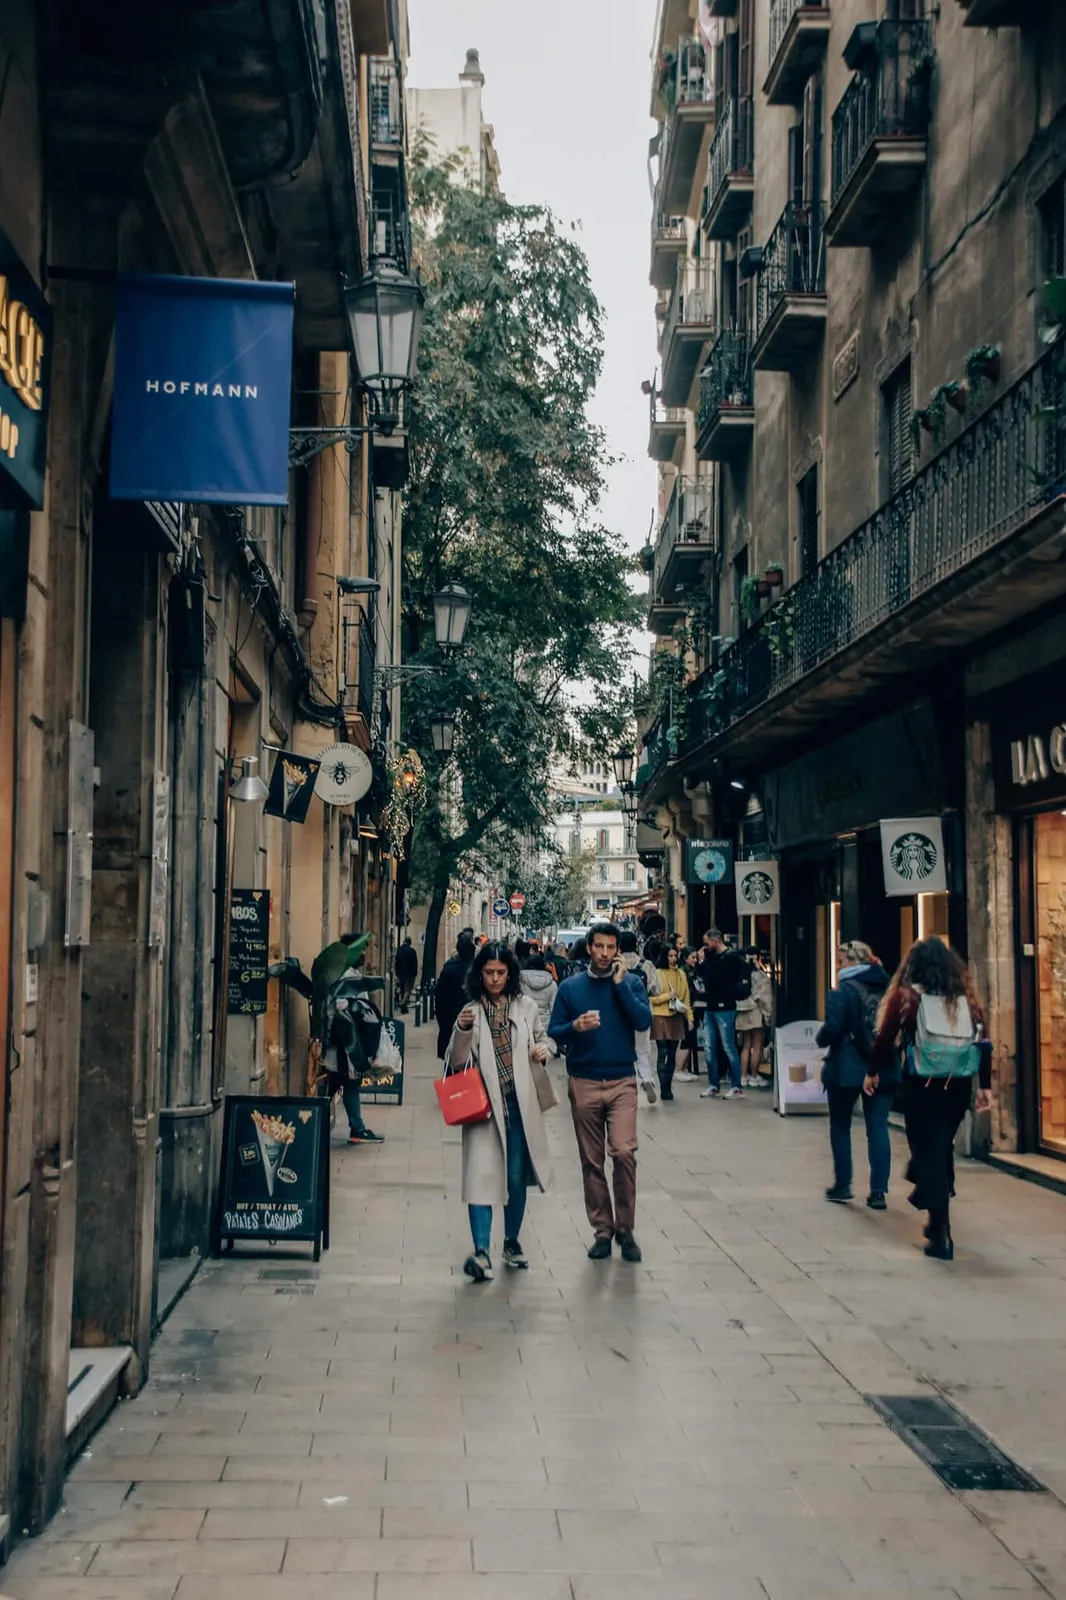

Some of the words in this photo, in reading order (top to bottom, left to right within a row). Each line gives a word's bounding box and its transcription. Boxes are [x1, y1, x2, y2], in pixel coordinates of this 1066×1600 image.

[146, 380, 258, 399] HOFMANN
[256, 1202, 276, 1211] TODAY
[224, 1211, 259, 1230] PATATES
[264, 1208, 303, 1231] CASOLANES
